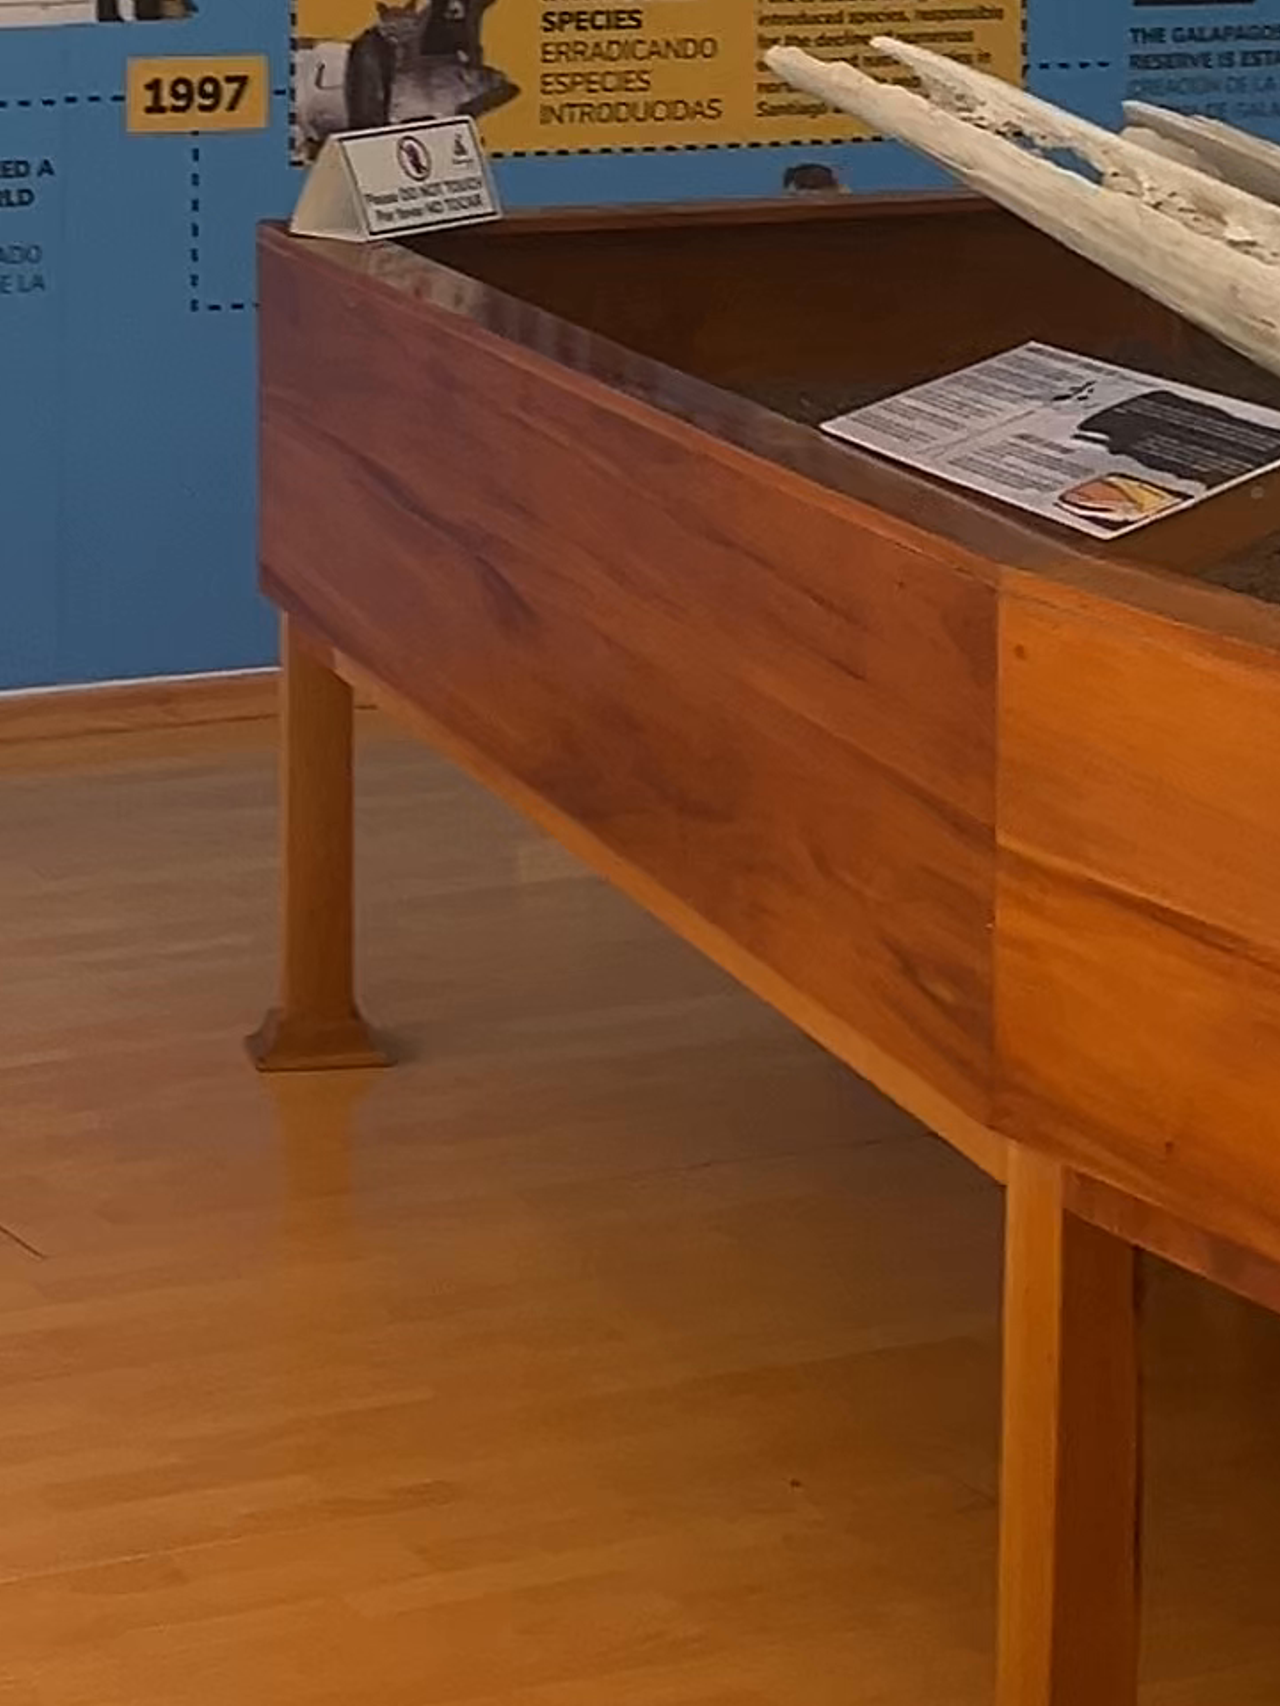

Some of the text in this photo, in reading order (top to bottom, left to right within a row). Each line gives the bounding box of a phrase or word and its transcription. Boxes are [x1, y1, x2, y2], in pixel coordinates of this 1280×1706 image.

[542, 9, 642, 30] SPECIES
[541, 37, 717, 62] ERRADICANDO
[540, 71, 651, 92] ESPECIES
[145, 76, 249, 114] 1997
[37, 159, 54, 177] A
